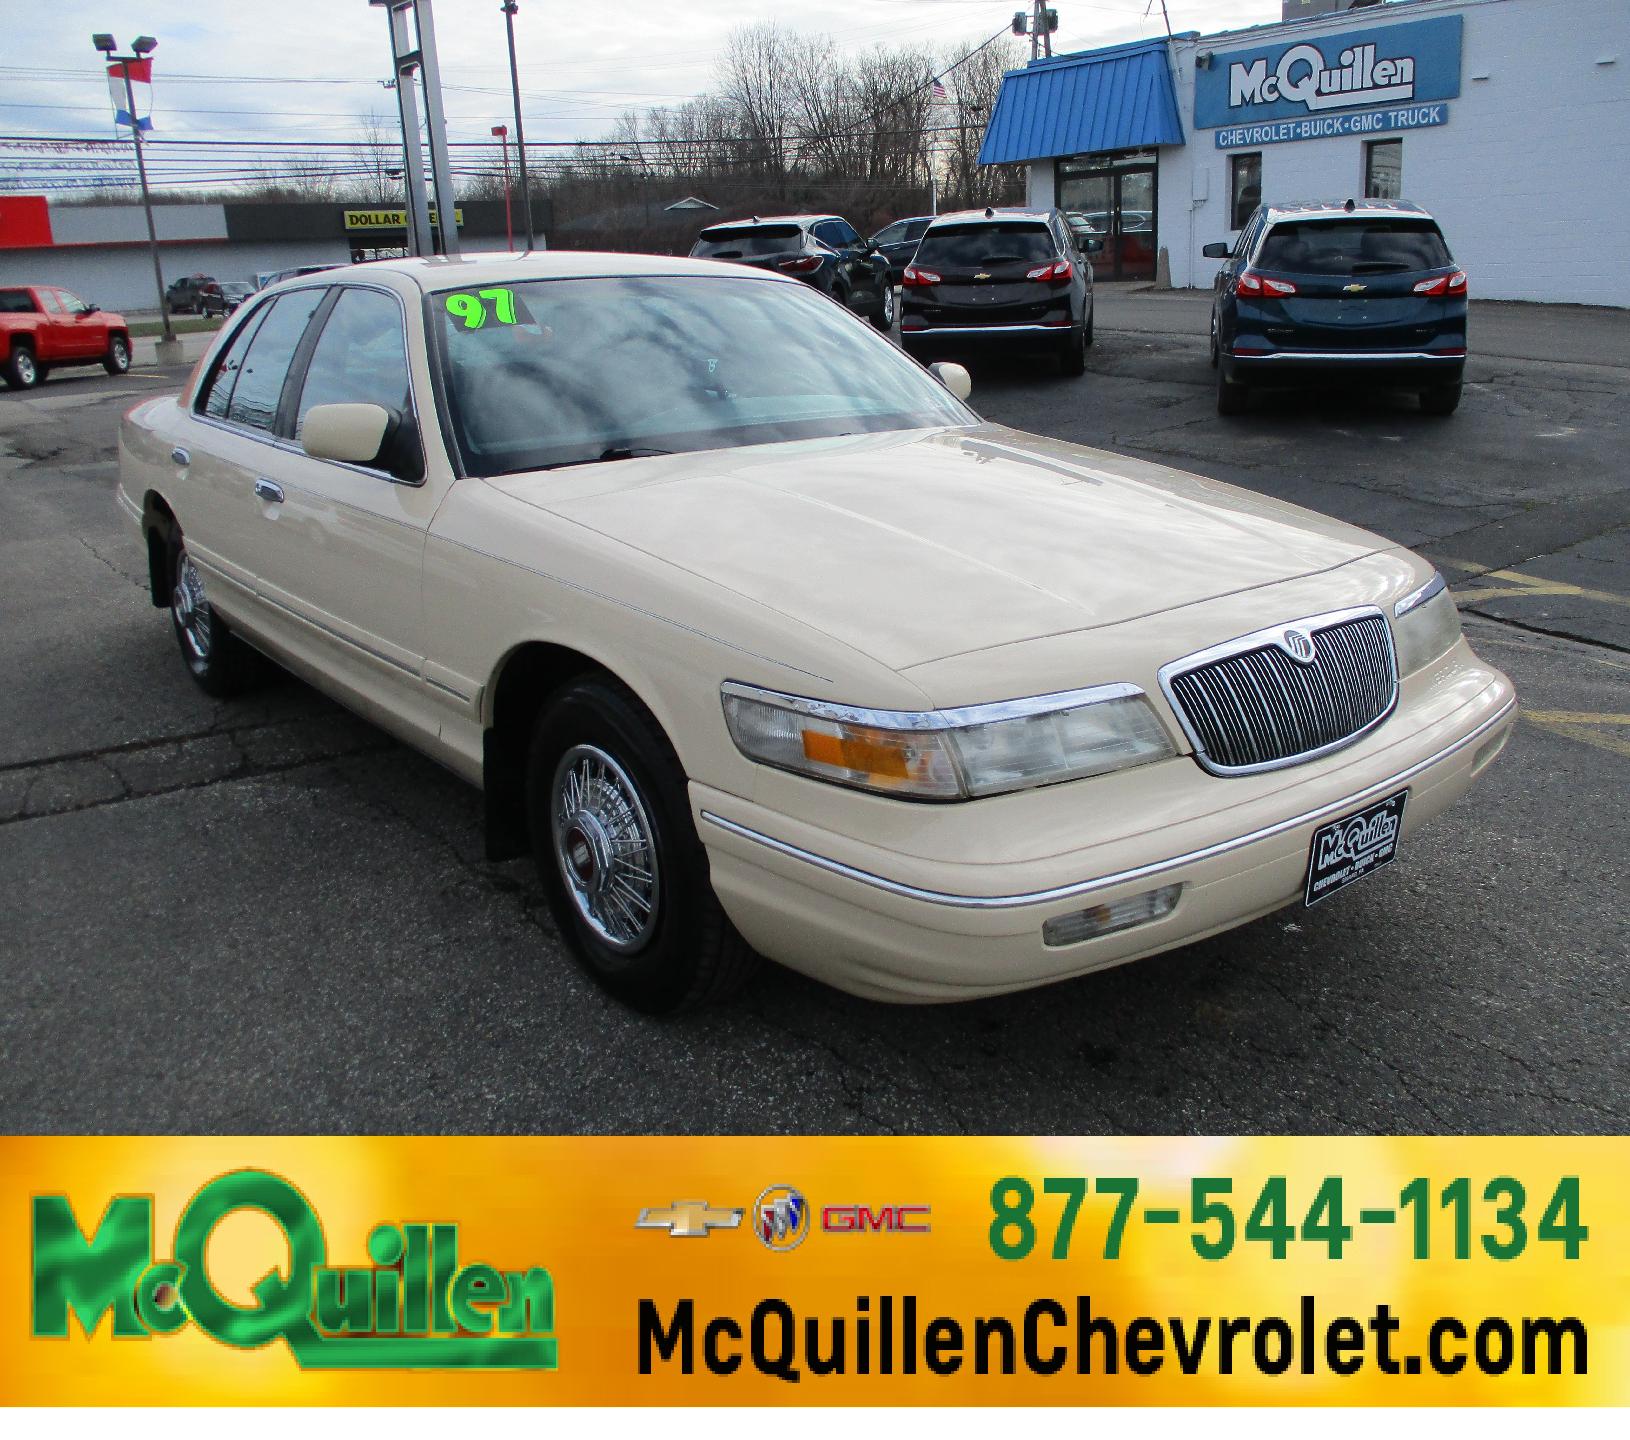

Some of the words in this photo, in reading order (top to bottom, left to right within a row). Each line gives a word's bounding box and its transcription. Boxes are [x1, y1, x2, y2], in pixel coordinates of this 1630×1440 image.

[1229, 43, 1415, 111] McQuillen
[1388, 107, 1441, 127] TRUCK
[349, 213, 401, 226] DOLLAR
[445, 288, 517, 329] 97
[1317, 809, 1399, 871] McQuillen
